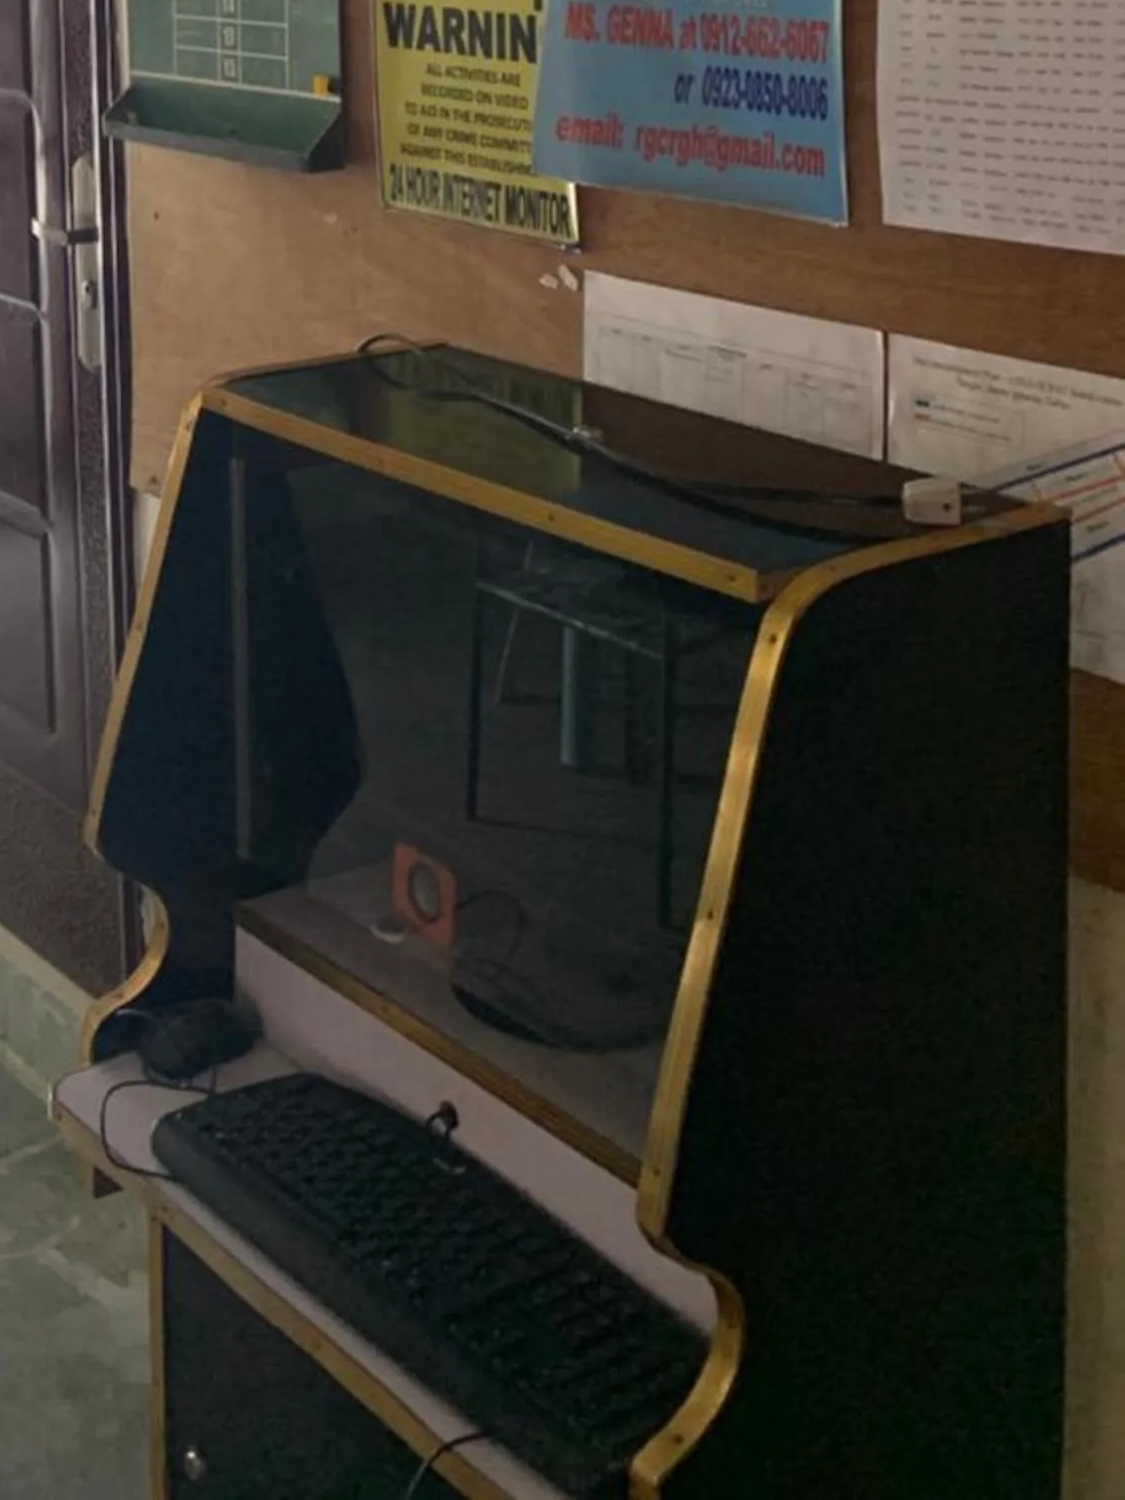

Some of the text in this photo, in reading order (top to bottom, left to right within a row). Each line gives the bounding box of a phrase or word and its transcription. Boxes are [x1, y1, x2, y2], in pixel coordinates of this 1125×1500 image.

[383, 2, 537, 64] WARNIN
[565, 1, 600, 43] MS.
[500, 72, 521, 87] ARE
[674, 73, 695, 104] or
[404, 100, 418, 116] TO
[453, 109, 471, 123] THE
[476, 90, 493, 105] ON
[495, 93, 529, 111] VIDEO
[554, 112, 624, 148] email:
[405, 163, 441, 209] HOUR
[442, 172, 503, 223] INTERNET
[504, 184, 573, 240] MONITOR
